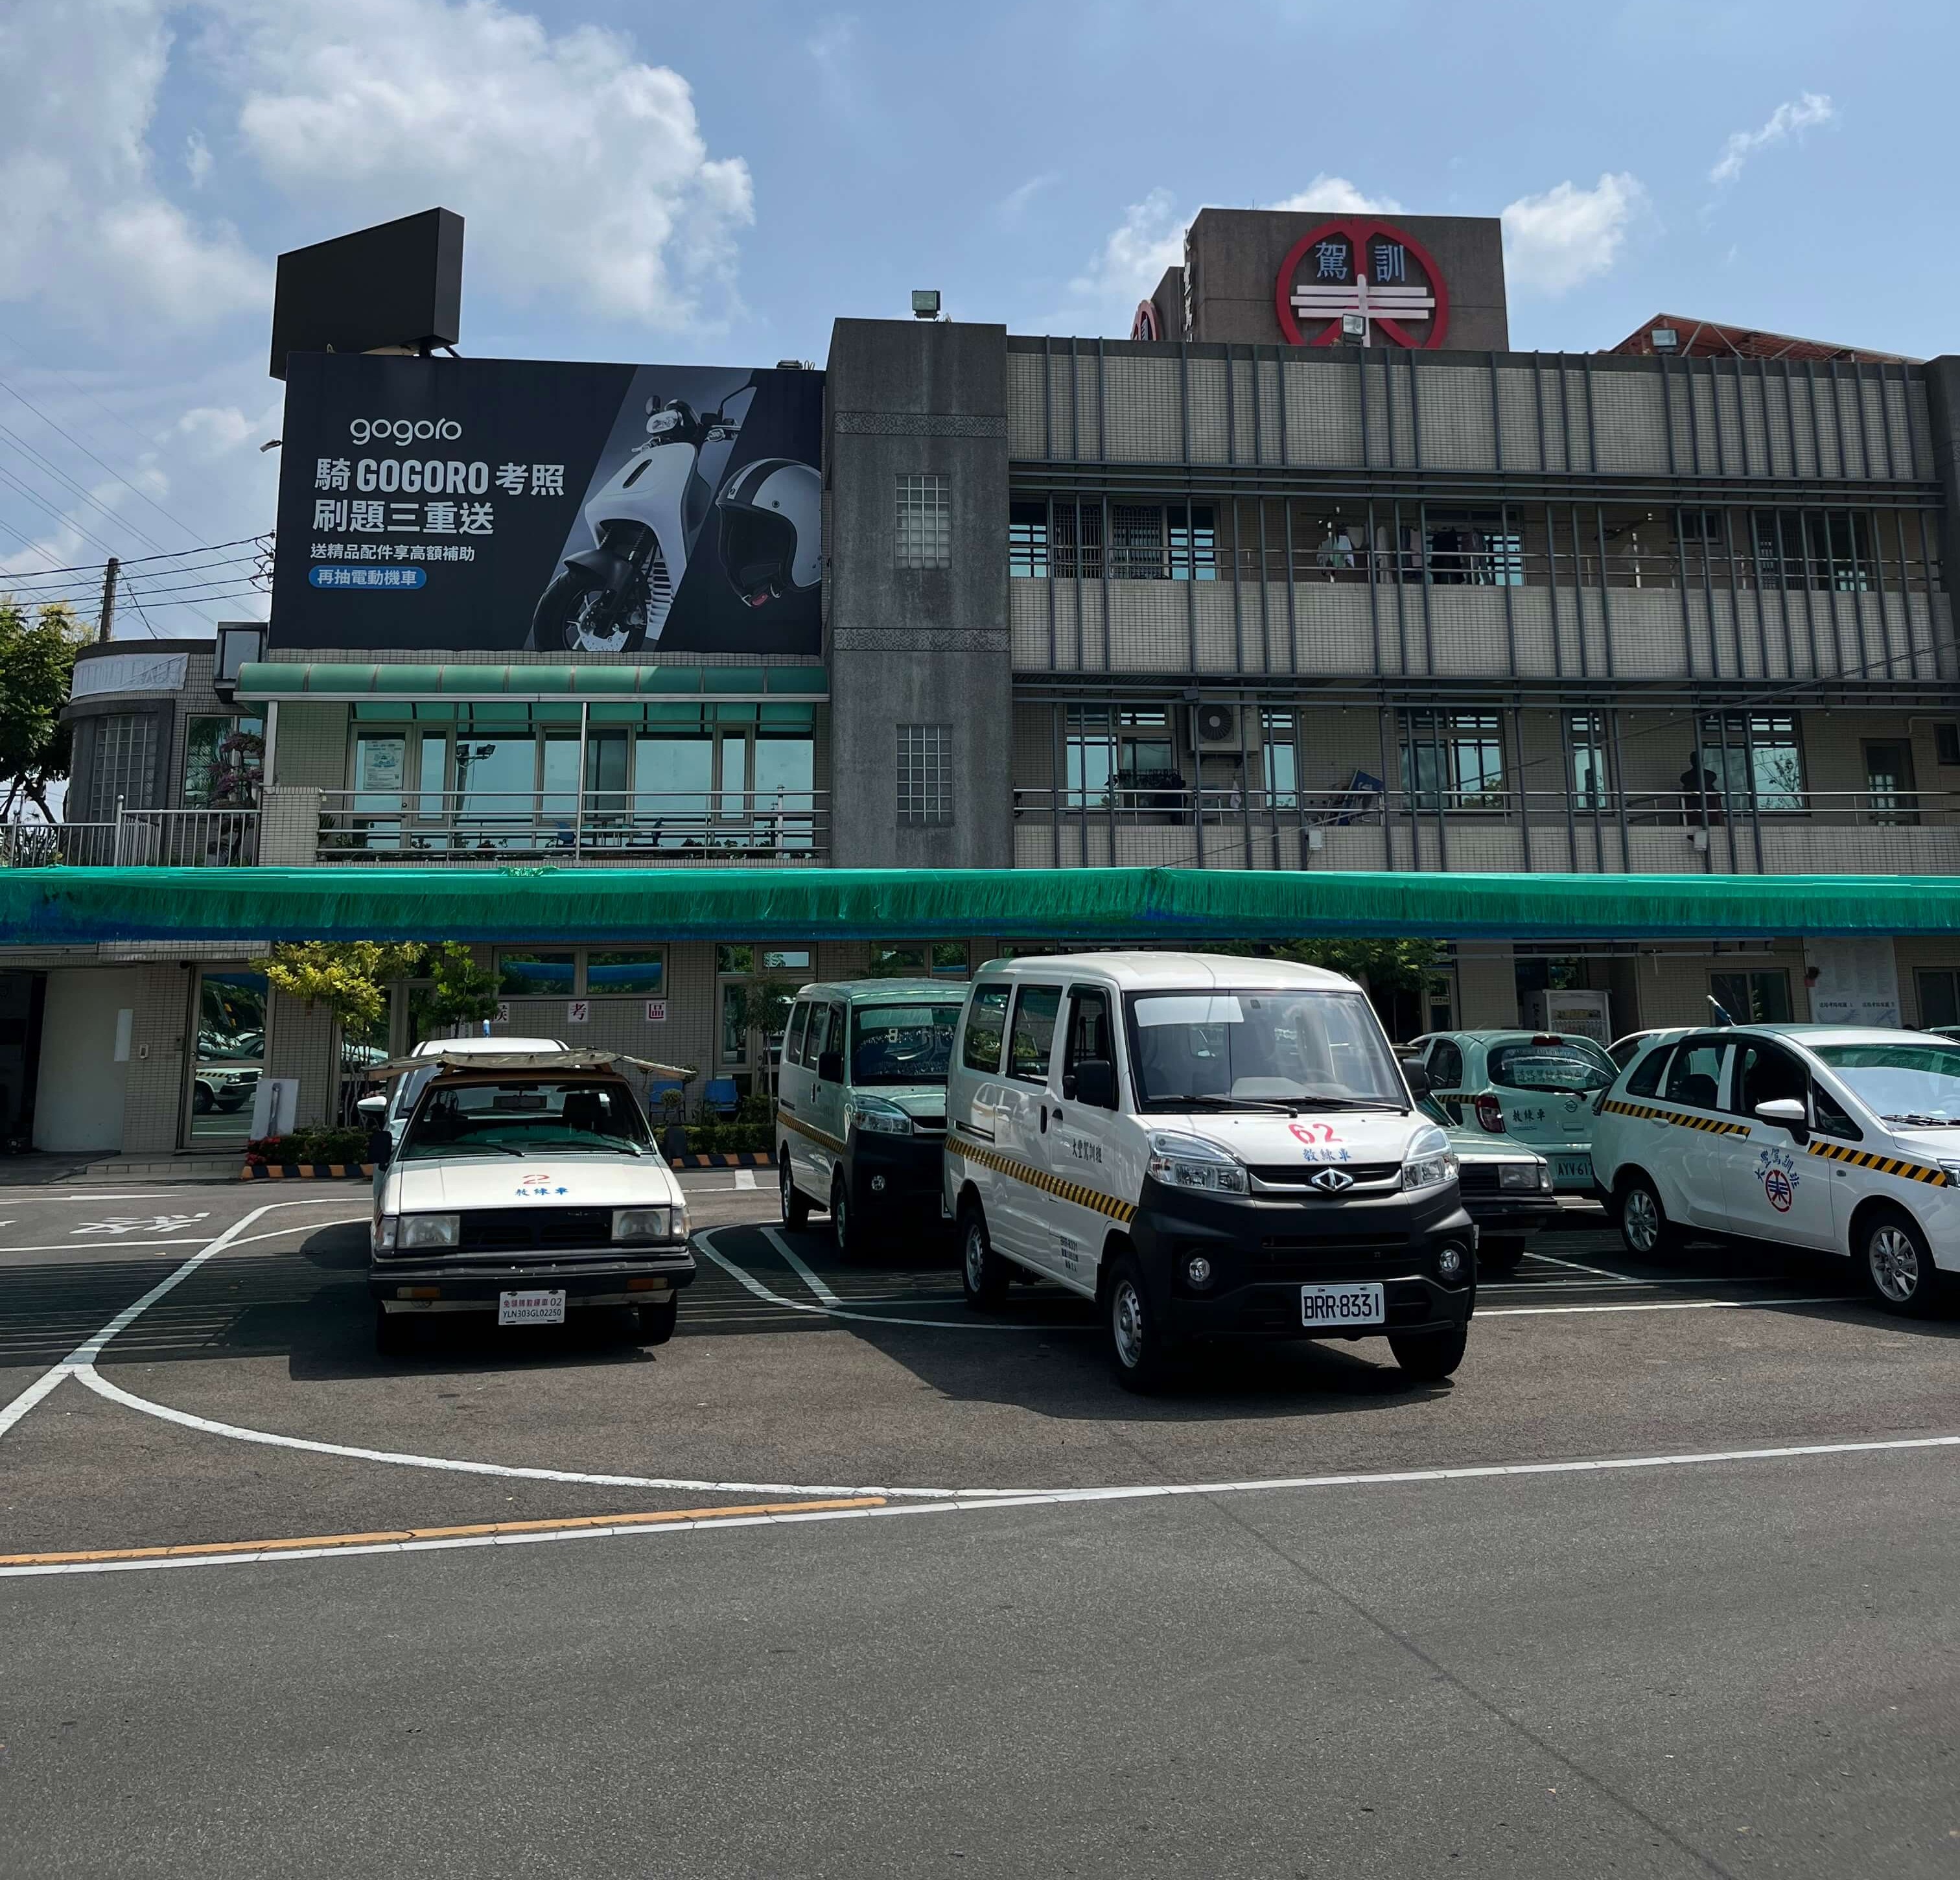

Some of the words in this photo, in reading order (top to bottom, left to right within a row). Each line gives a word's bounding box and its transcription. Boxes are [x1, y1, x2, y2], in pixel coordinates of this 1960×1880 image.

[1315, 242, 1405, 281] 駕訓
[350, 417, 462, 446] gogoro
[356, 458, 489, 495] GOGORO
[495, 462, 565, 496] 考照
[312, 499, 494, 535] 刷題三重送
[310, 543, 475, 561] 送精品配件享高額補助
[317, 569, 417, 586] 再抽電動機車
[1289, 1123, 1343, 1144] 62
[1303, 1148, 1351, 1162] 教練車
[522, 1174, 550, 1184] 2
[1303, 1293, 1380, 1319] BRR-8331
